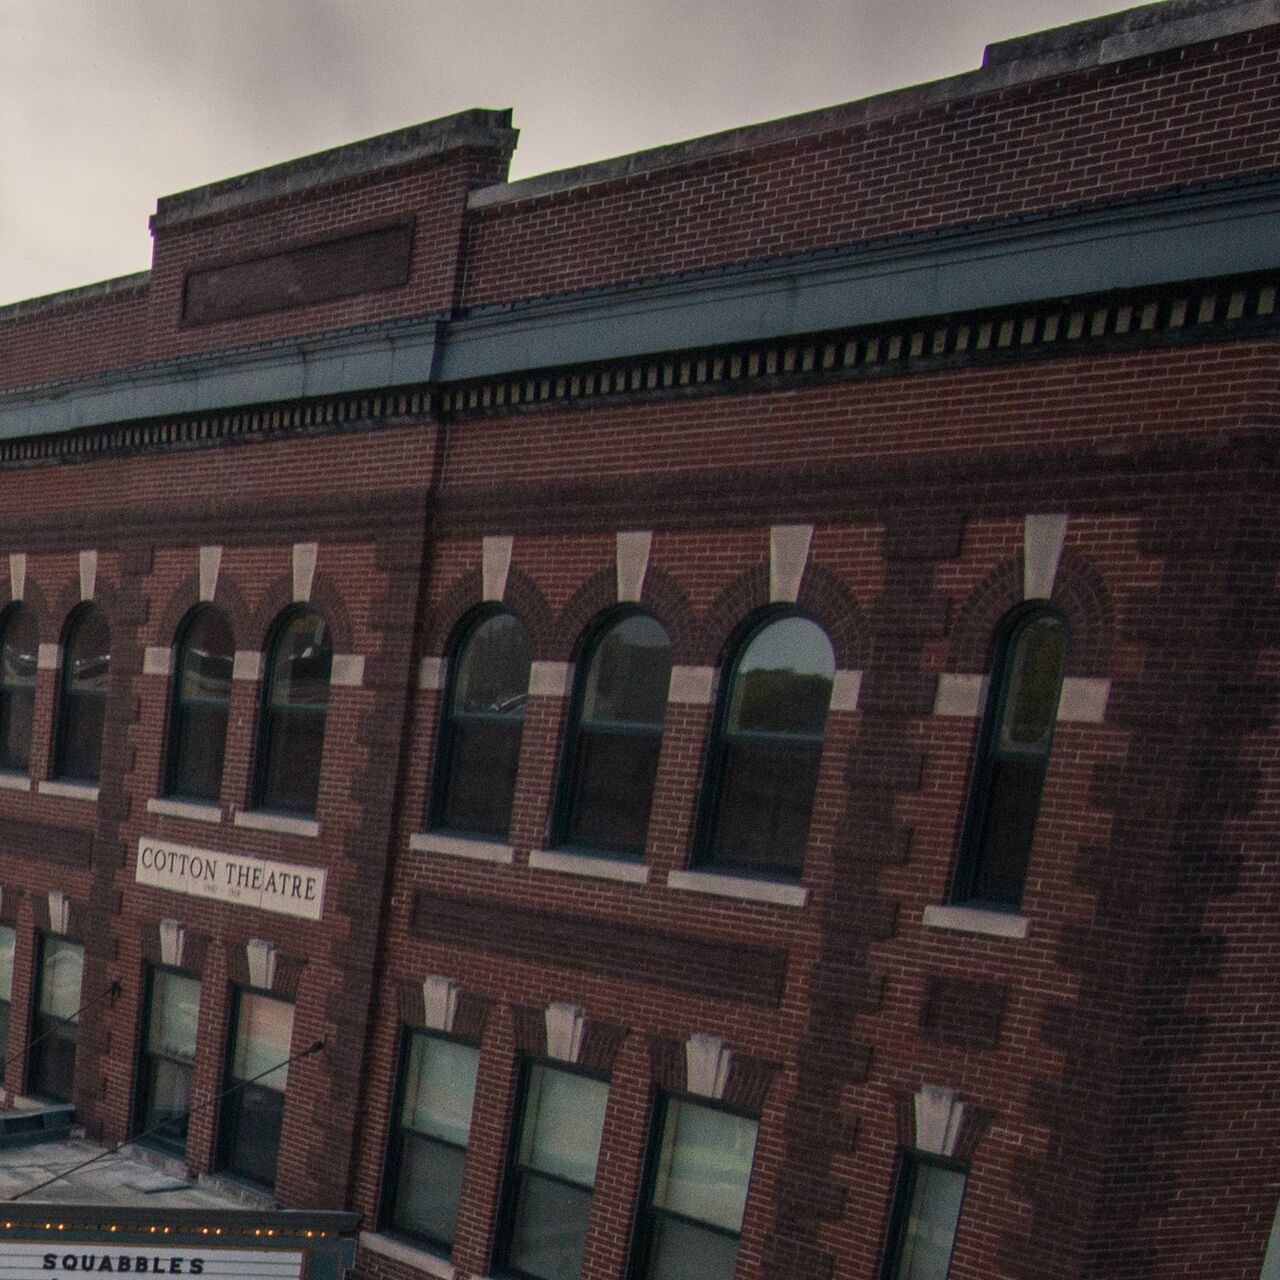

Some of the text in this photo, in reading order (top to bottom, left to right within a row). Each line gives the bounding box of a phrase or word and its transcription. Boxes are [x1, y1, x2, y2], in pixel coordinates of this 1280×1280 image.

[140, 846, 317, 901] COTTON THEATRE
[42, 1252, 206, 1275] SQUABBLES
